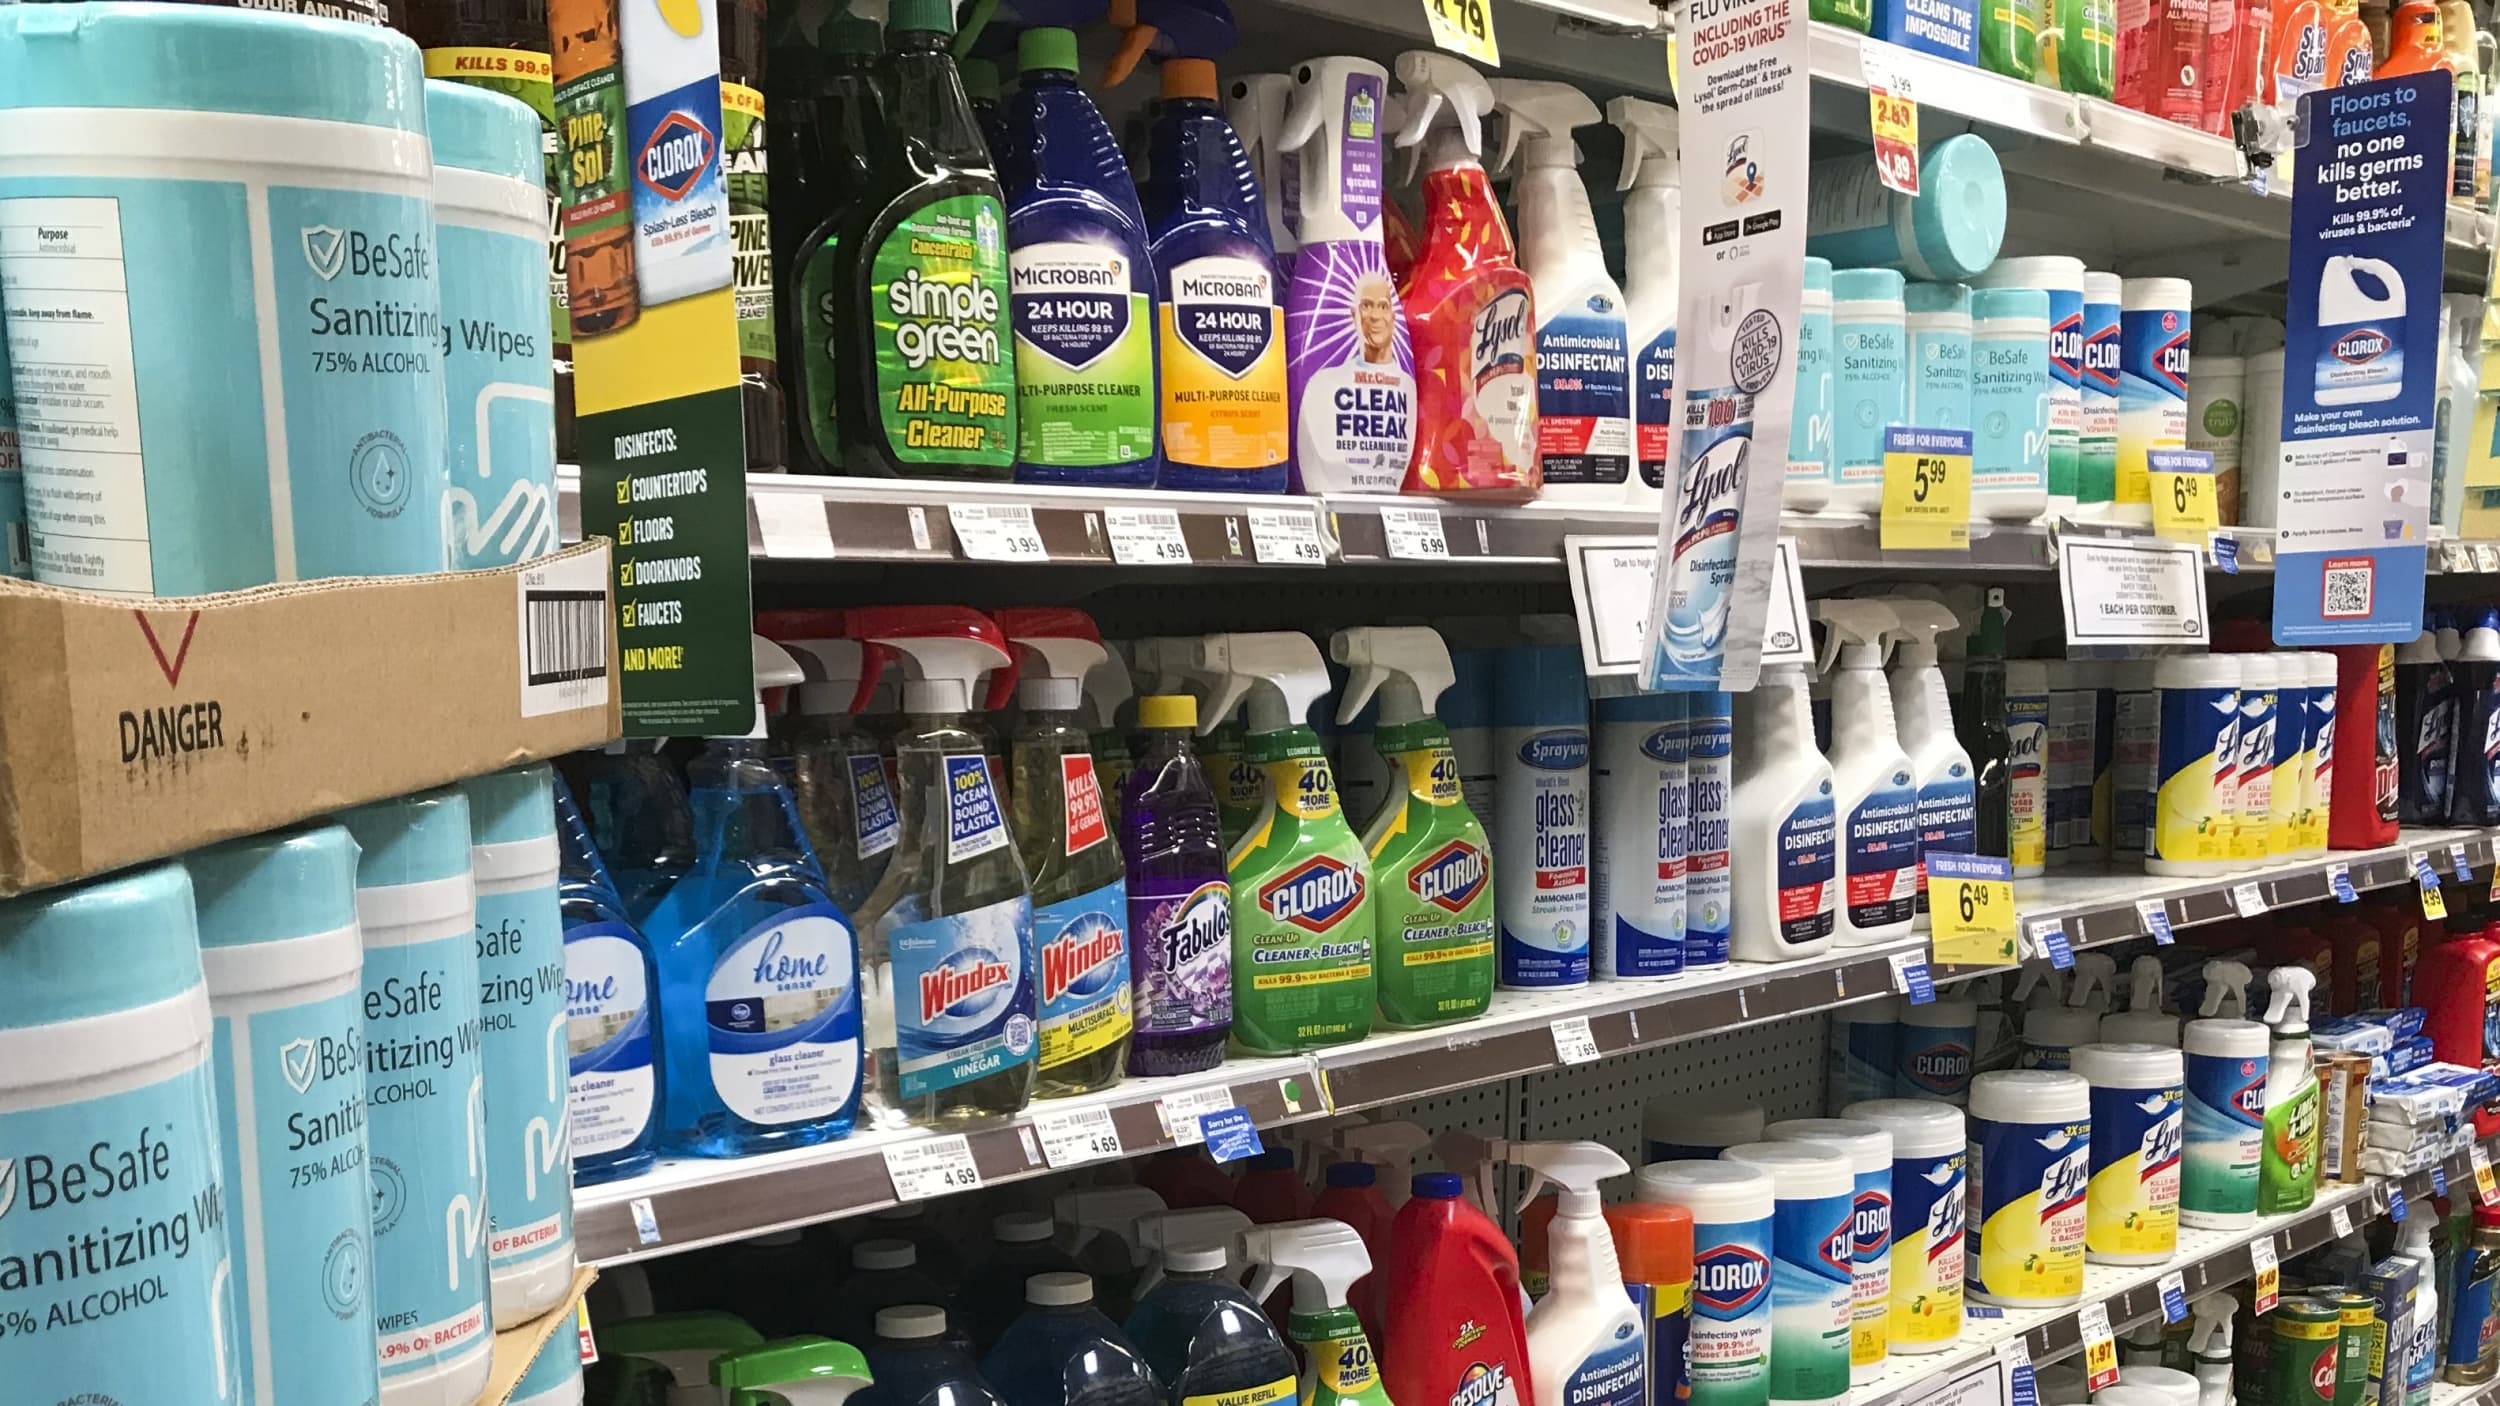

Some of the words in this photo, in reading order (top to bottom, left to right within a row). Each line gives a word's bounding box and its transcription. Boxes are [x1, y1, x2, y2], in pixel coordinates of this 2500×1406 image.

[1690, 0, 1719, 23] FLU
[1952, 9, 1973, 30] THE
[1693, 9, 1763, 47] INCLUDING
[1764, 0, 1790, 23] THE
[1905, 15, 1971, 51] IMPOSSIBLE
[1692, 35, 1746, 67] COVID-19
[455, 56, 508, 72] KILLS
[1707, 65, 1745, 86] Download
[1746, 61, 1758, 75] the
[1759, 56, 1777, 71] Free
[1762, 73, 1769, 83] &
[1770, 64, 1792, 80] track
[2296, 48, 2326, 78] Span
[2344, 47, 2372, 79] Spic
[1702, 101, 1715, 114] the
[1716, 92, 1744, 111] spread
[1745, 89, 1754, 101] of
[1754, 80, 1784, 99] illness!
[2330, 91, 2390, 117] Floors
[2395, 87, 2417, 105] to
[2332, 111, 2412, 137] faucets,
[647, 131, 705, 183] CLOROX
[2337, 142, 2363, 159] no
[2366, 134, 2405, 153] one
[573, 144, 604, 188] Sol
[2317, 164, 2356, 185] kills
[2359, 153, 2424, 182] germs
[2336, 178, 2402, 204] better.
[690, 203, 718, 224] Bleach
[2332, 210, 2355, 225] Kills
[2356, 206, 2390, 223] 99.9%
[2391, 205, 2403, 217] of
[37, 227, 69, 242] Purpose
[2319, 226, 2356, 241] viruses
[2357, 224, 2366, 235] &
[351, 231, 431, 280] BeSafe
[1717, 249, 1726, 261] or
[1014, 266, 1114, 286] MICROBAN
[889, 269, 1000, 326] simple
[1183, 279, 1262, 298] MICROBAN
[310, 297, 438, 347] Sanitizing
[1027, 301, 1053, 319] 24
[1057, 301, 1114, 320] HOUR
[1195, 312, 1217, 329] 24
[1220, 312, 1262, 331] HOUR
[1031, 323, 1058, 334] KEEPS
[1058, 323, 1091, 334] KILLING
[1474, 299, 1525, 362] Lysol
[1742, 314, 1765, 333] TESTED
[463, 319, 535, 360] Wipes
[895, 320, 1000, 369] green
[1198, 333, 1220, 343] KEEPS
[1220, 334, 1246, 344] KILLING
[1542, 334, 1613, 351] Antimicrobial
[1613, 338, 1620, 350] &
[1741, 327, 1769, 352] KILLS
[1859, 333, 1895, 350] BeSafe
[2337, 336, 2383, 357] CLOROX
[311, 352, 357, 374] 75%
[361, 351, 432, 374] ALCOHOL
[1536, 353, 1625, 374] DISINFECTANT
[1735, 335, 1777, 369] COVID-19
[1989, 350, 2029, 367] BeSafe
[1843, 356, 1898, 372] Sanitizing
[1097, 383, 1142, 398] CLEANER
[1973, 372, 2032, 388] Sanitizing
[898, 383, 1007, 418] All-Purpose
[1175, 391, 1250, 403] MULTI-PURPOSE
[1251, 391, 1281, 403] CLEANER
[1334, 387, 1408, 415] CLEAN
[1686, 412, 1705, 426] OVER
[1707, 397, 1736, 428] 100
[2294, 411, 2320, 423] Make
[2321, 409, 2342, 422] your
[2343, 408, 2363, 418] own
[906, 419, 985, 450] Cleaner
[1335, 413, 1408, 441] FREAK
[2294, 421, 2347, 435] disinfecting
[2348, 417, 2380, 431] bleach
[2380, 415, 2421, 428] solution.
[614, 427, 678, 461] DISINFECTS:
[1336, 439, 1355, 451] DEEP
[1357, 439, 1396, 453] CLEANING
[1893, 433, 1915, 446] FRESH
[1916, 433, 1930, 446] FOR
[632, 468, 708, 503] COUNTERTOPS
[1682, 440, 1745, 525] Lysol
[633, 516, 674, 543] FLOORS
[1008, 537, 1040, 553] 3.99
[1156, 543, 1185, 558] 4.99
[1294, 544, 1321, 559] 4.99
[1421, 537, 1445, 553] 6.99
[635, 555, 701, 585] DOORKNOBS
[1689, 554, 1737, 575] Disinfectant
[1709, 570, 1735, 586] Spray
[637, 600, 682, 627] FAUCETS
[2104, 604, 2124, 615] EACH
[2125, 605, 2138, 615] PER
[2139, 605, 2178, 616] CUSTOMER.
[624, 647, 646, 672] AND
[647, 645, 682, 670] MORE!
[118, 700, 225, 764] DANGER
[953, 771, 985, 791] 100%
[1068, 773, 1094, 797] KILLS
[1431, 782, 1457, 794] MORE
[953, 789, 989, 806] OCEAN
[1069, 795, 1097, 819] 99.9%
[1299, 794, 1330, 806] MORE
[1687, 777, 1722, 819] glass
[1917, 795, 1962, 809] Antimicrobial
[954, 800, 990, 821] BOUND
[1080, 811, 1101, 831] GERMS
[1535, 790, 1575, 833] glass
[1860, 803, 1909, 819] Antimicrobial
[953, 812, 996, 837] PLASTIC
[1535, 830, 1586, 868] cleaner
[1419, 847, 1485, 902] CLOROX
[1935, 860, 1957, 873] FRESH
[1959, 860, 1971, 873] FOR
[1272, 863, 1358, 922] CLOROX
[1534, 894, 1574, 904] AMMONIA
[1403, 928, 1450, 942] CLEANER
[1457, 922, 1487, 935] BLEACH
[752, 932, 829, 984] home
[1253, 948, 1310, 964] CLEANER
[1320, 943, 1360, 958] BLEACH
[1041, 925, 1124, 1007] Windex
[919, 960, 1009, 1025] Windex
[1067, 1004, 1117, 1034] MULTISURFACE
[768, 1053, 793, 1067] glass
[794, 1048, 824, 1063] cleaner
[1576, 1042, 1597, 1058] 3.69
[952, 1054, 1001, 1080] VINEGAR
[1915, 1055, 1970, 1077] CLOROX
[1091, 1135, 1118, 1154] 4.69
[24, 1124, 171, 1211] BeSafe
[289, 1162, 328, 1189] 75%
[944, 1167, 976, 1187] 4.69
[492, 1235, 509, 1253] OF
[511, 1224, 559, 1251] BACTERIA
[0, 1212, 191, 1289] anitizing
[46, 1274, 169, 1331] ALCOHOL
[433, 1315, 482, 1348] BACTERIA
[1740, 1327, 1762, 1339] Wipes
[1695, 1342, 1714, 1351] Kills
[1716, 1340, 1744, 1350] 99.9%
[2089, 1341, 2112, 1365] 1.97
[1339, 1369, 1370, 1382] MORE
[1579, 1354, 1634, 1384] Antimicrobial
[1450, 1361, 1505, 1406] RESOLVE
[1573, 1363, 1643, 1405] DISINFECTANT
[1216, 1391, 1249, 1406] VALUE
[1251, 1387, 1277, 1404] REFILL
